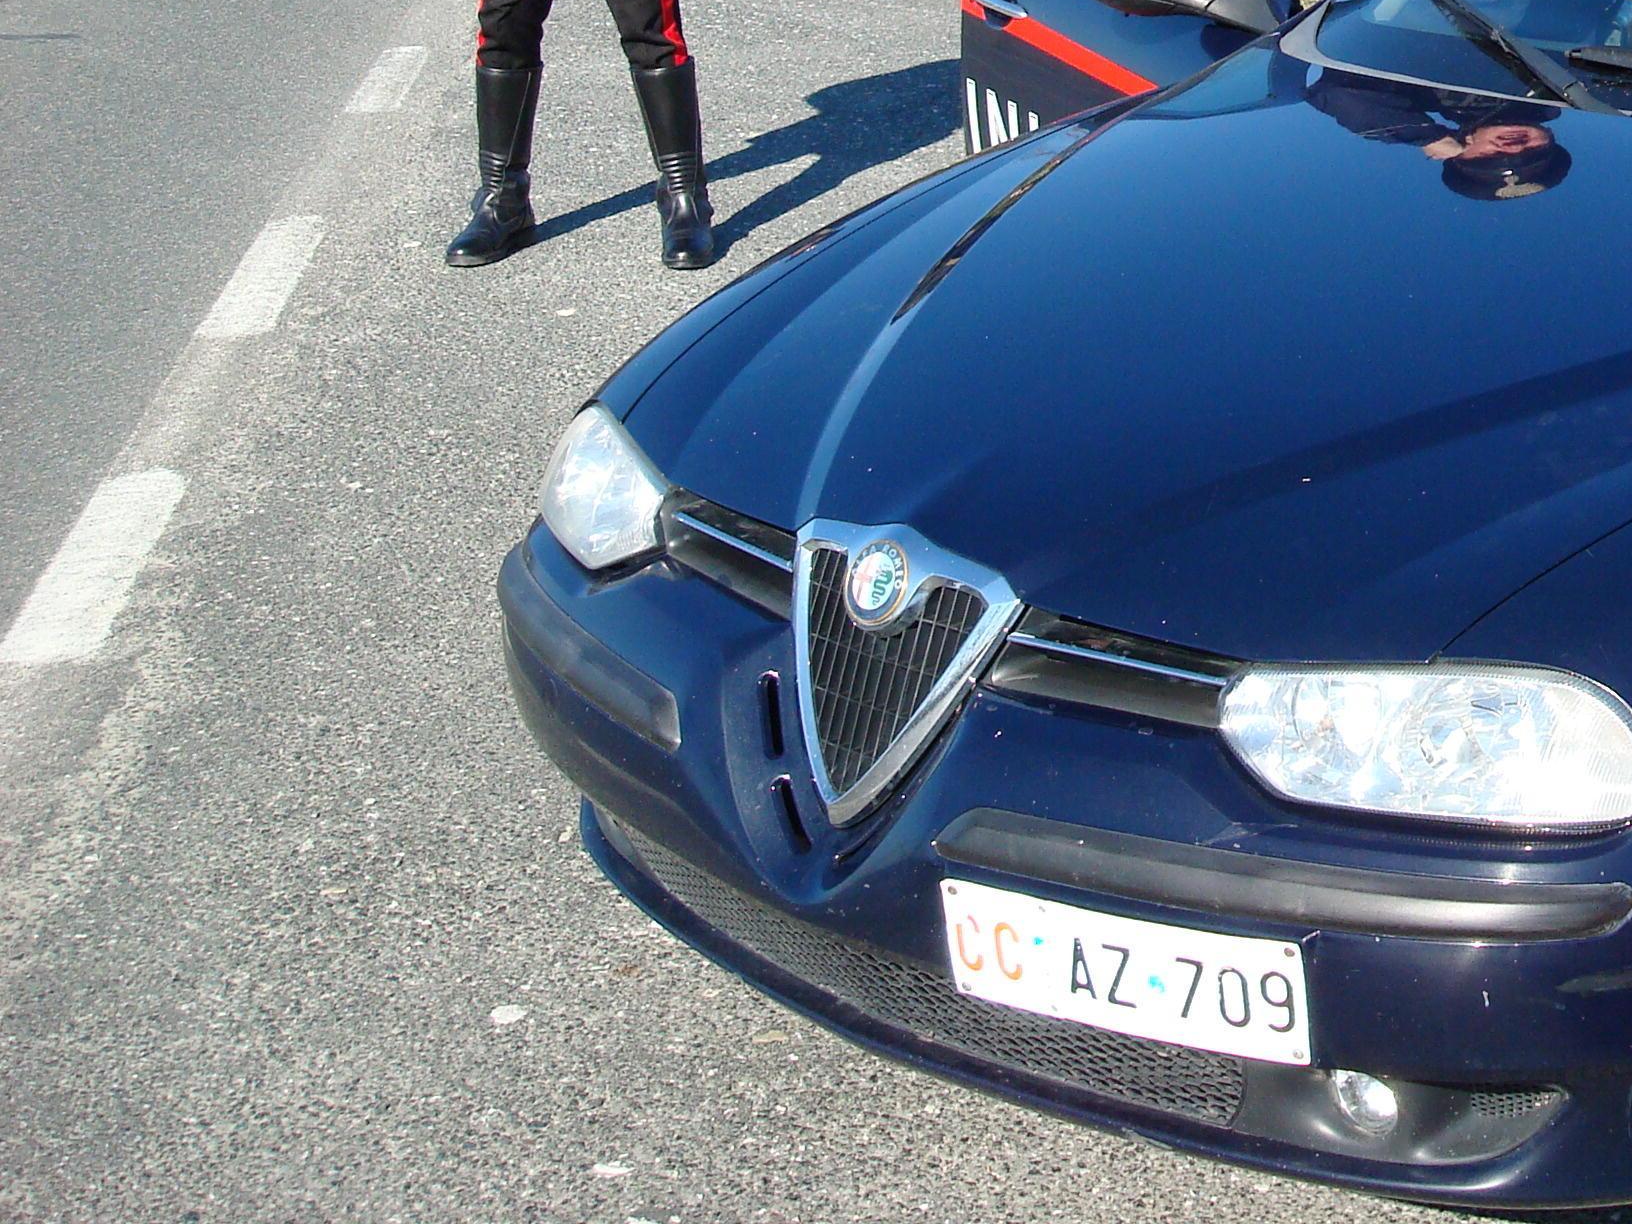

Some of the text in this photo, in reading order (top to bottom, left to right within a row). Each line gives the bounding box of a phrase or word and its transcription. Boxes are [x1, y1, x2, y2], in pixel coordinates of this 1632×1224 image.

[955, 915, 1297, 1033] CC AZ 709
